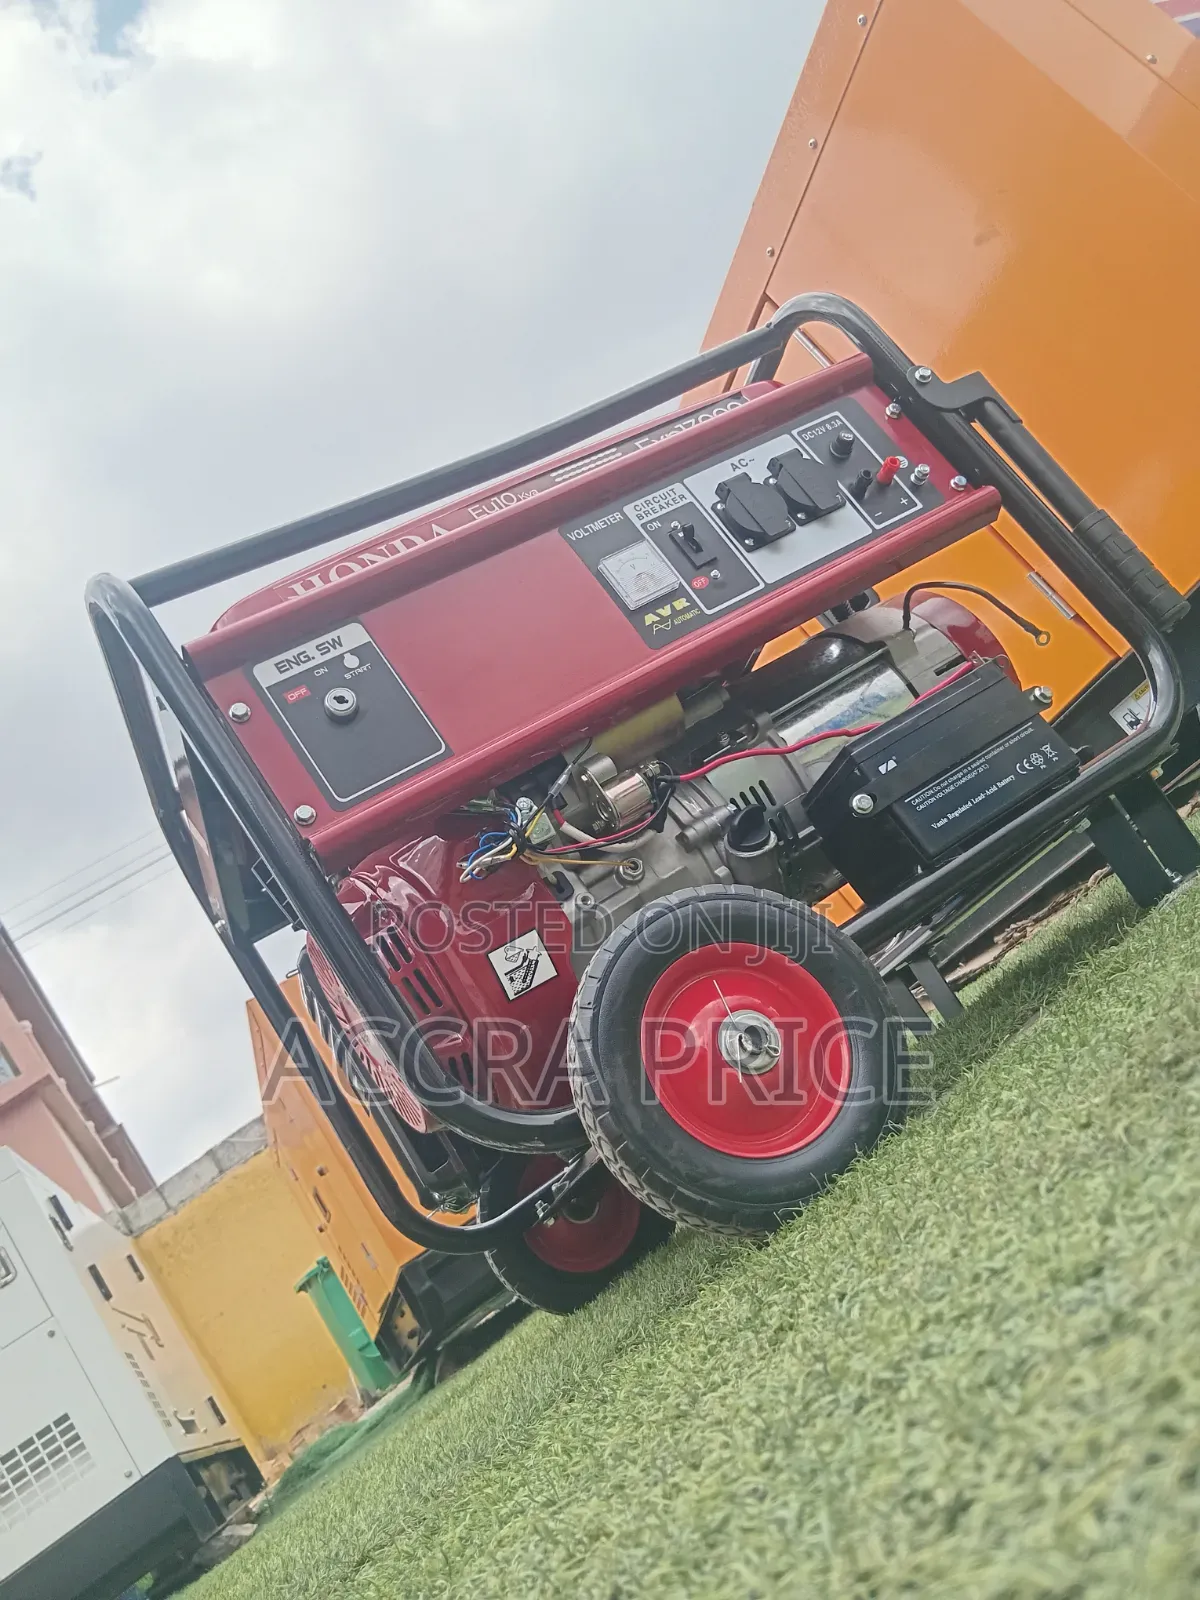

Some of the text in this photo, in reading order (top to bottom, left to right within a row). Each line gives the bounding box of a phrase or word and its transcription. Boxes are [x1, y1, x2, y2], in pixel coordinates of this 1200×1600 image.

[801, 425, 826, 441] DC12V
[825, 419, 843, 430] 8.3A
[633, 488, 677, 512] CIRCUIT
[635, 493, 687, 521] BREAKER
[567, 512, 624, 541] VOLTMETER
[647, 520, 662, 531] ON
[693, 577, 707, 588] OFF
[644, 597, 691, 626] AVR
[673, 608, 701, 625] AUTOMATIC
[274, 635, 343, 674] ENG. SW
[313, 666, 328, 677] ON
[344, 662, 372, 679] START
[287, 687, 307, 701] OFF
[916, 797, 936, 811] CAUTION
[935, 784, 955, 799] VOLTAGE
[947, 801, 973, 820] Regulated
[996, 774, 1016, 788] Battery
